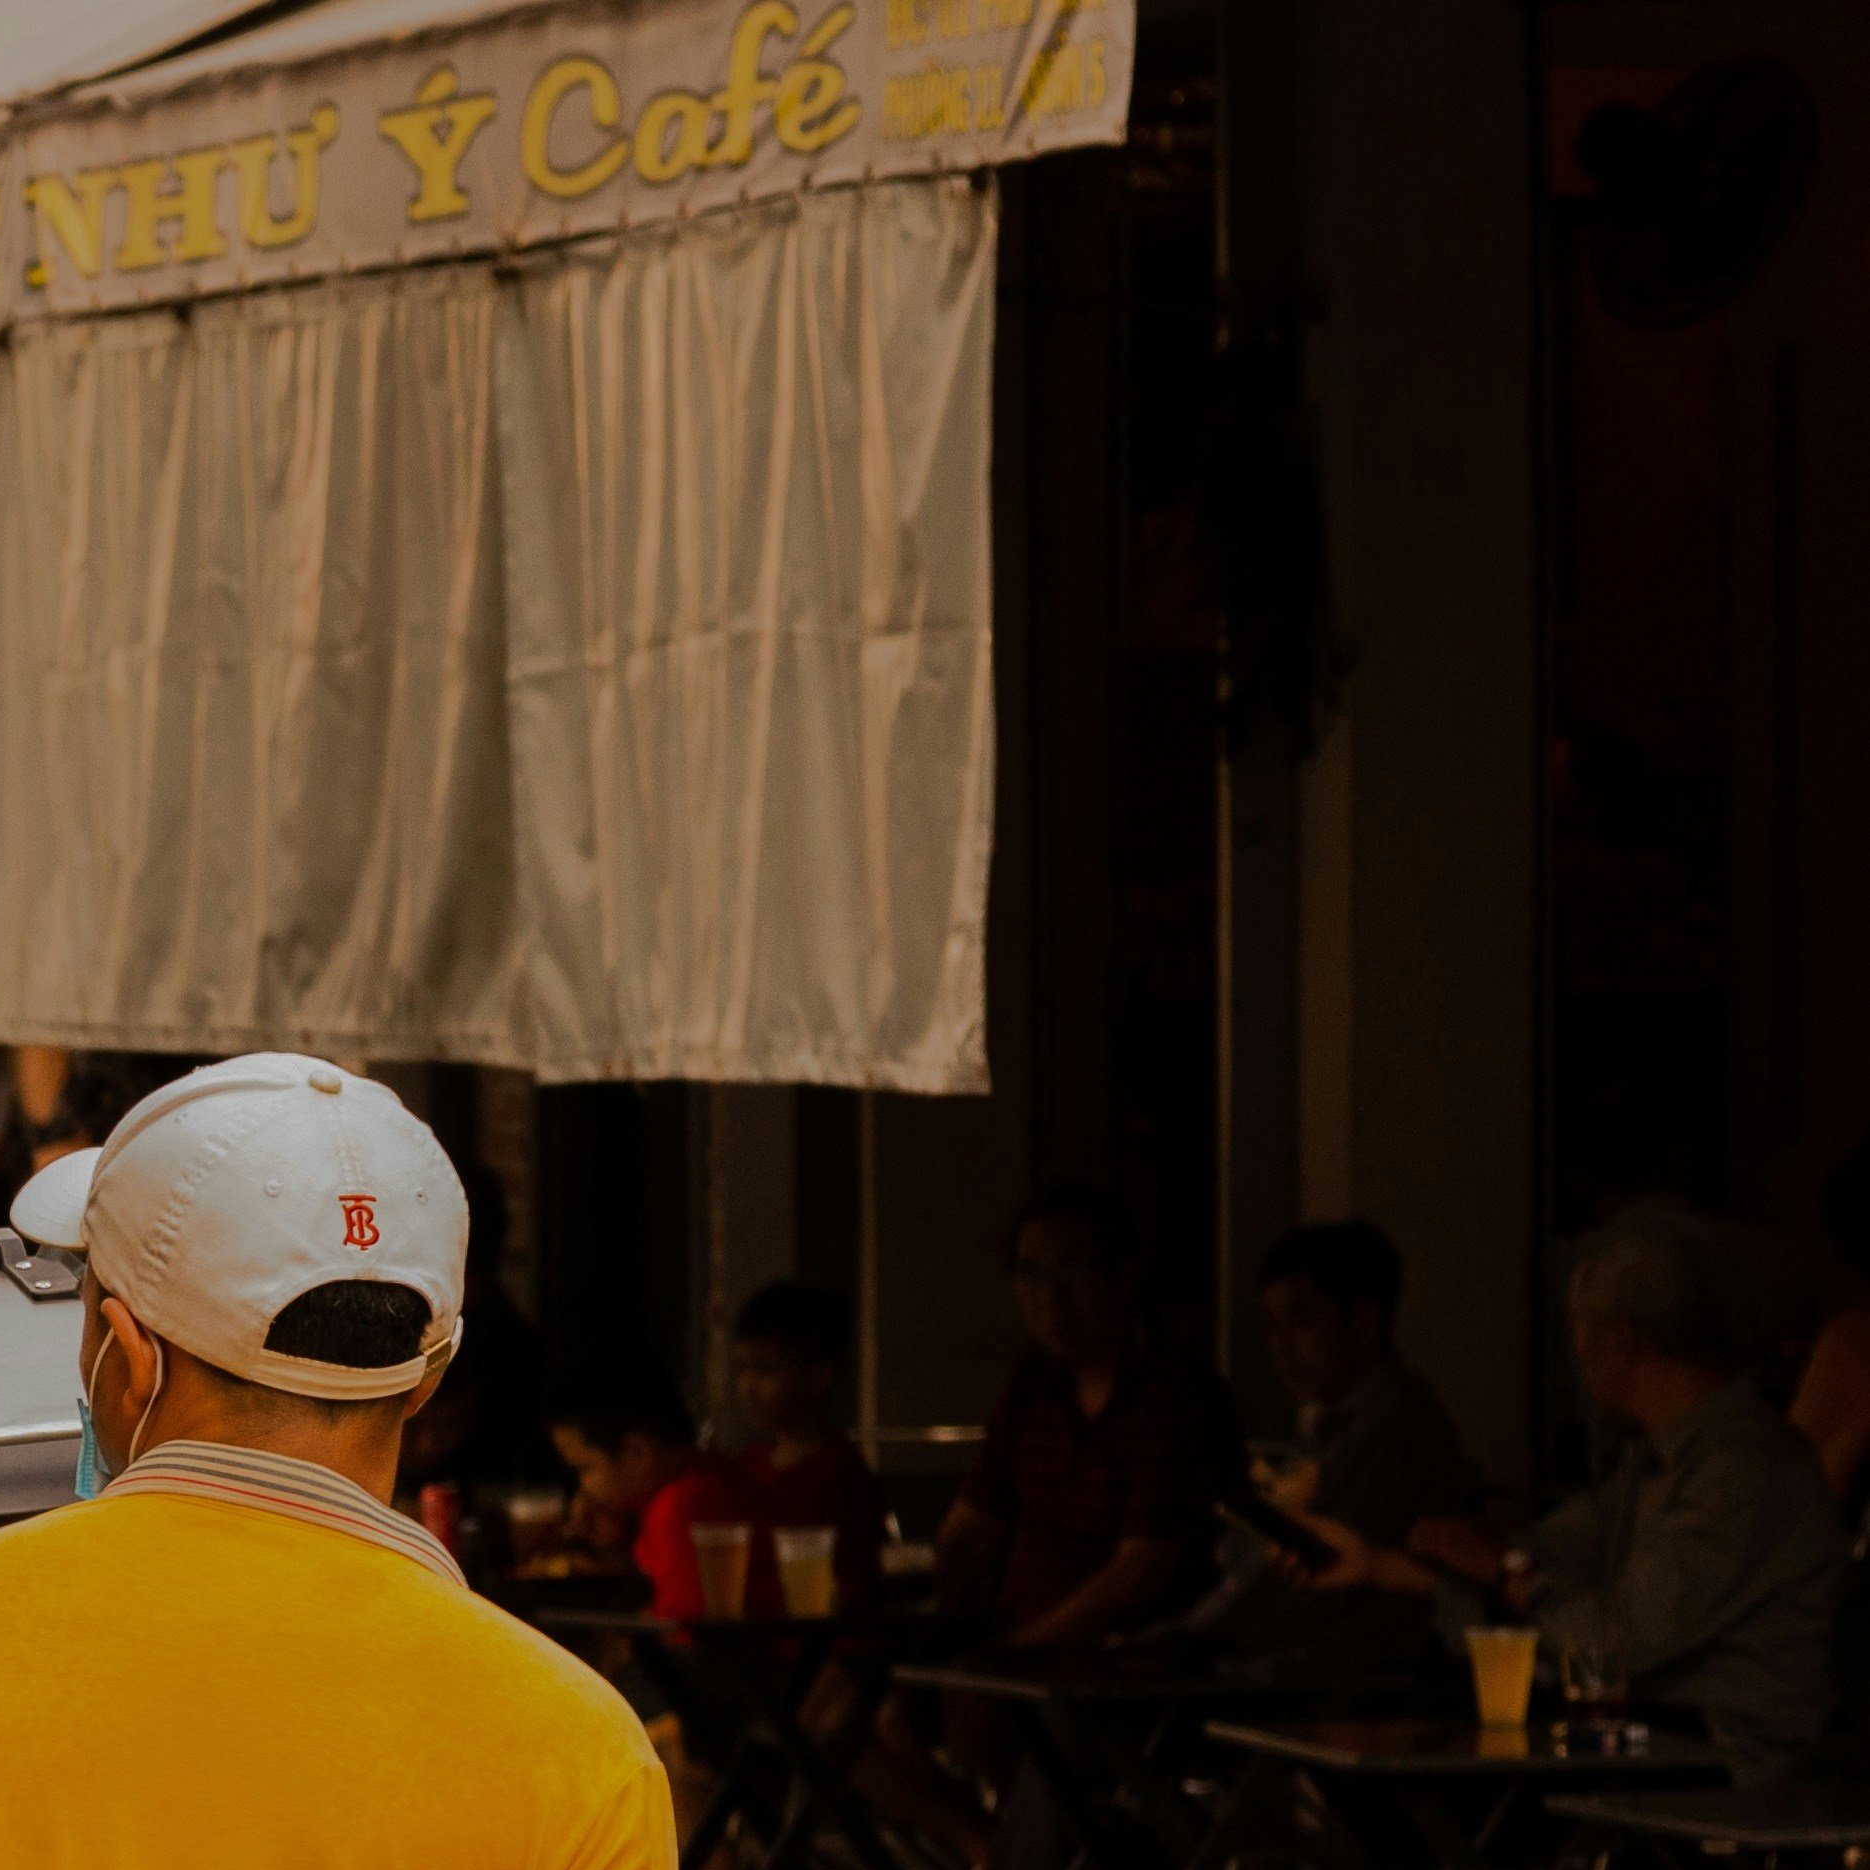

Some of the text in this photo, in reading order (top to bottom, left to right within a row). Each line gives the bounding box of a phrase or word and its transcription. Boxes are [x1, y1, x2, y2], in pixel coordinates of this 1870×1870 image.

[27, 101, 340, 290] NHƯ
[379, 67, 496, 223] Ý
[520, 0, 861, 199] Café
